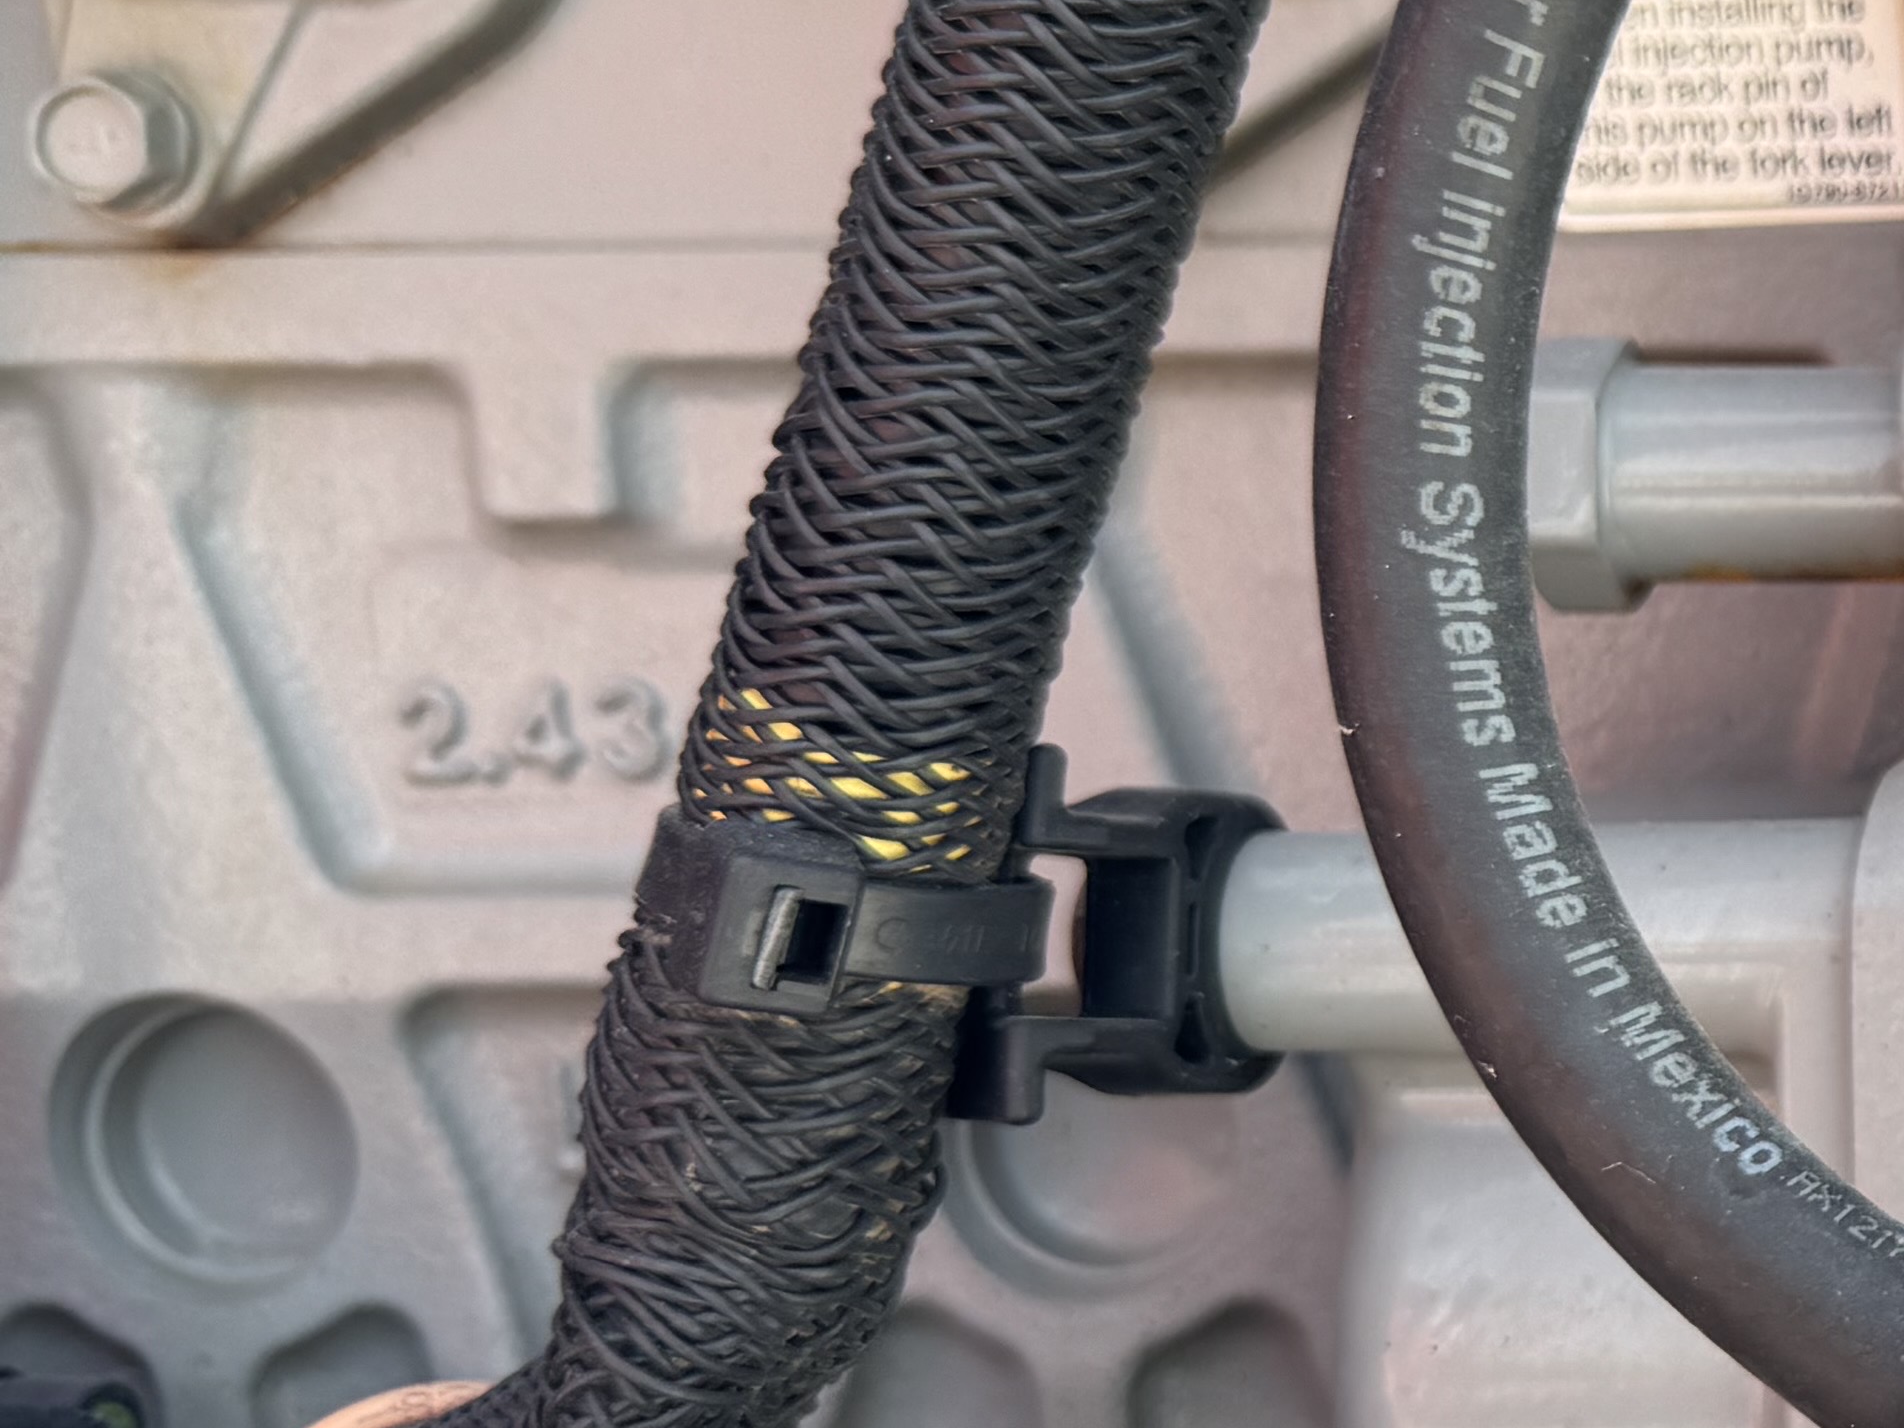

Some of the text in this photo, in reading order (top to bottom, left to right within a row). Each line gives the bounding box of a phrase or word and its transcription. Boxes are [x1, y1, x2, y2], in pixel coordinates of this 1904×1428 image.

[1452, 29, 1547, 181] Fuel
[1605, 69, 1829, 108] the rack pin of
[1634, 32, 1765, 76] injection
[1575, 150, 1641, 185] side
[1650, 149, 1681, 184] of
[1688, 148, 1742, 183] the
[1748, 145, 1810, 180] fork
[1637, 112, 1729, 153] pump
[1737, 112, 1778, 144] on
[1786, 106, 1839, 140] the
[1846, 102, 1893, 135] left
[1411, 188, 1507, 459] Injection
[1400, 480, 1518, 748] Systems
[1478, 762, 1589, 932] Made
[1566, 937, 1631, 1000] in
[1608, 1000, 1785, 1175] Mexico
